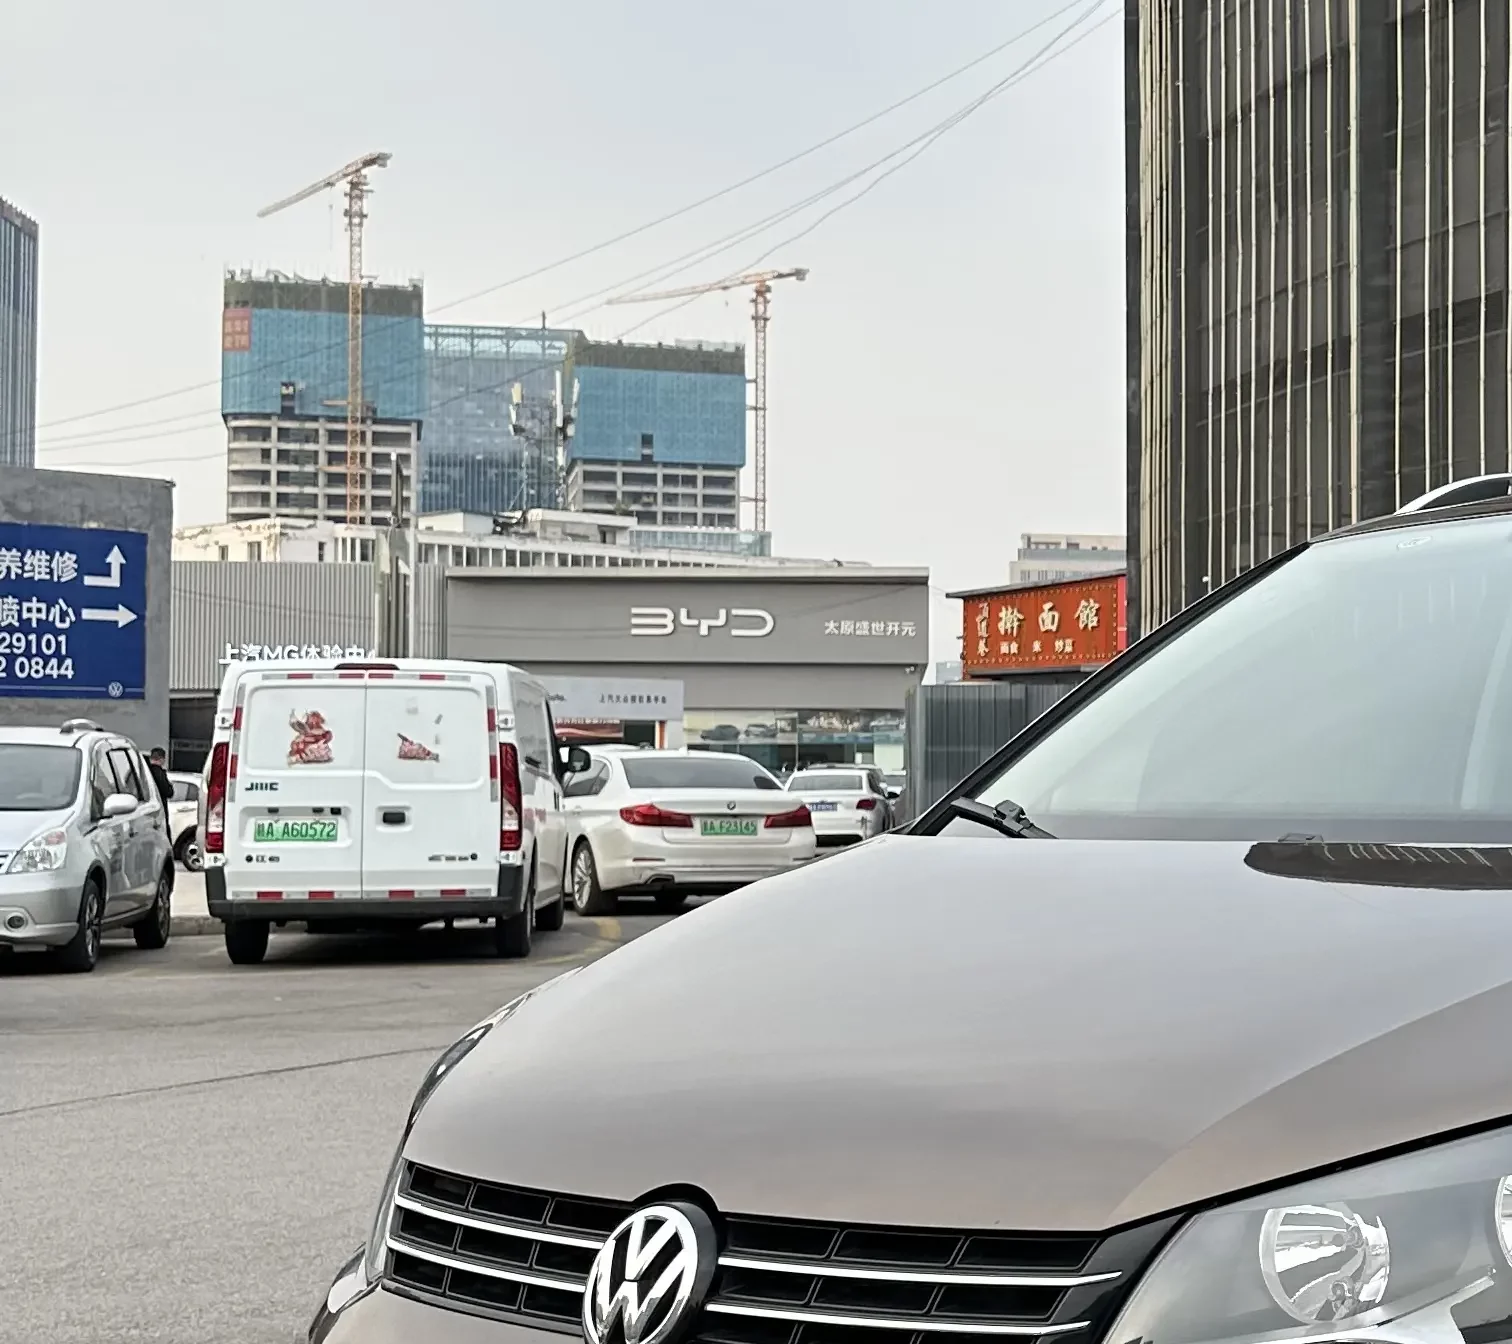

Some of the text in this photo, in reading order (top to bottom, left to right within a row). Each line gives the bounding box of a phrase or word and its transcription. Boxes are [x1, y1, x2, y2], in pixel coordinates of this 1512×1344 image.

[631, 607, 774, 637] BYD
[824, 621, 916, 637] 太原盛世开元
[14, 657, 75, 679] 0844
